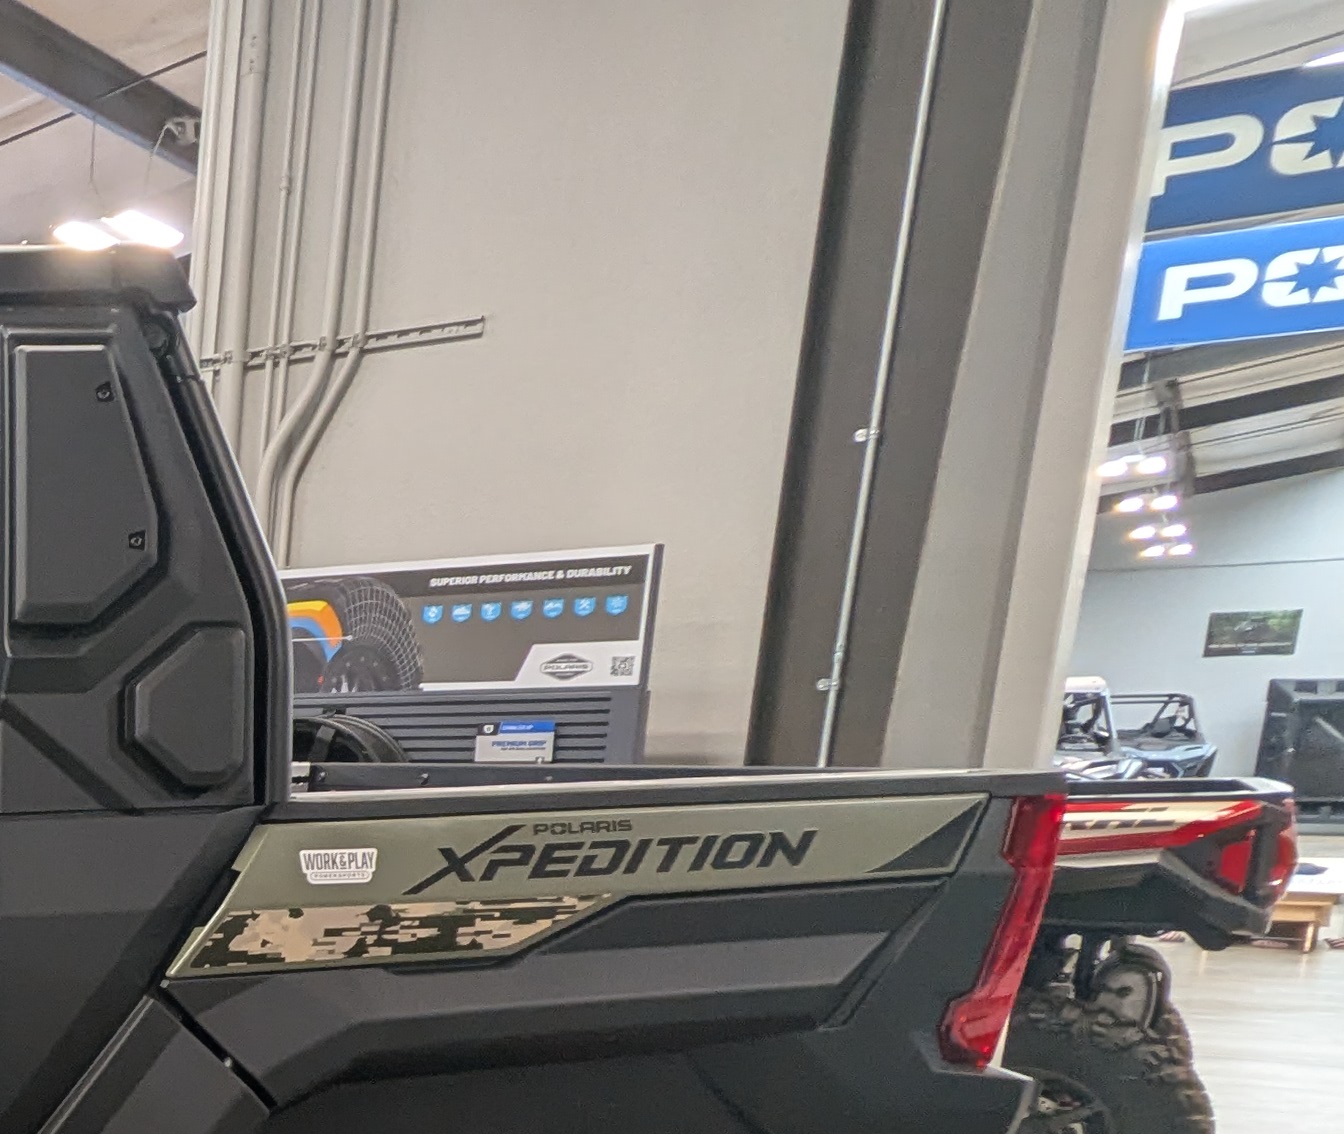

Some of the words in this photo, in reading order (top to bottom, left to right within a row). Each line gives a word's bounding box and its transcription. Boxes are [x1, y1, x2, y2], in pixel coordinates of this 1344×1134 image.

[429, 576, 479, 588] SUPERIOR
[479, 571, 555, 585] PERFORMANCE
[557, 570, 564, 580] &
[566, 565, 632, 580] DURABILITY
[532, 819, 633, 836] POLARIS
[402, 824, 818, 896] XPEDITION
